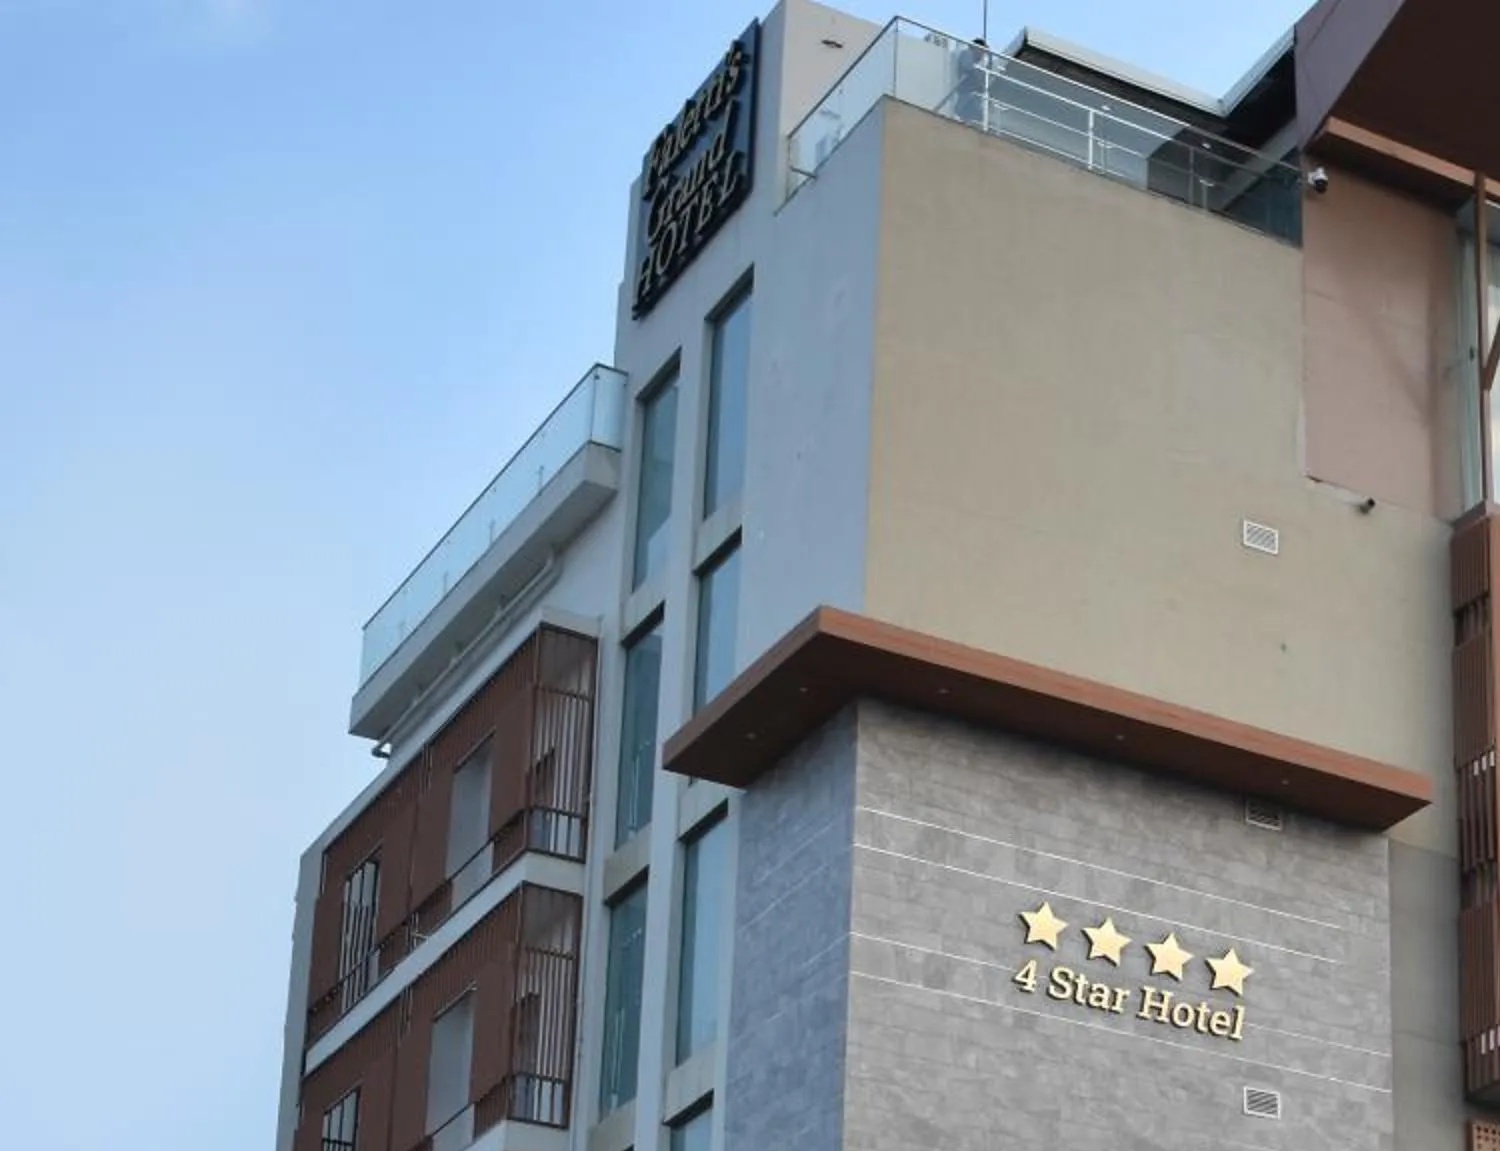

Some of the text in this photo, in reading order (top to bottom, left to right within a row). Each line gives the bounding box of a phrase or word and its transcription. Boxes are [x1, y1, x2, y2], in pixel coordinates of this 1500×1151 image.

[637, 150, 742, 298] HOTEL
[648, 98, 733, 245] Grand
[1013, 960, 1245, 1041] 4 Star Hotel
